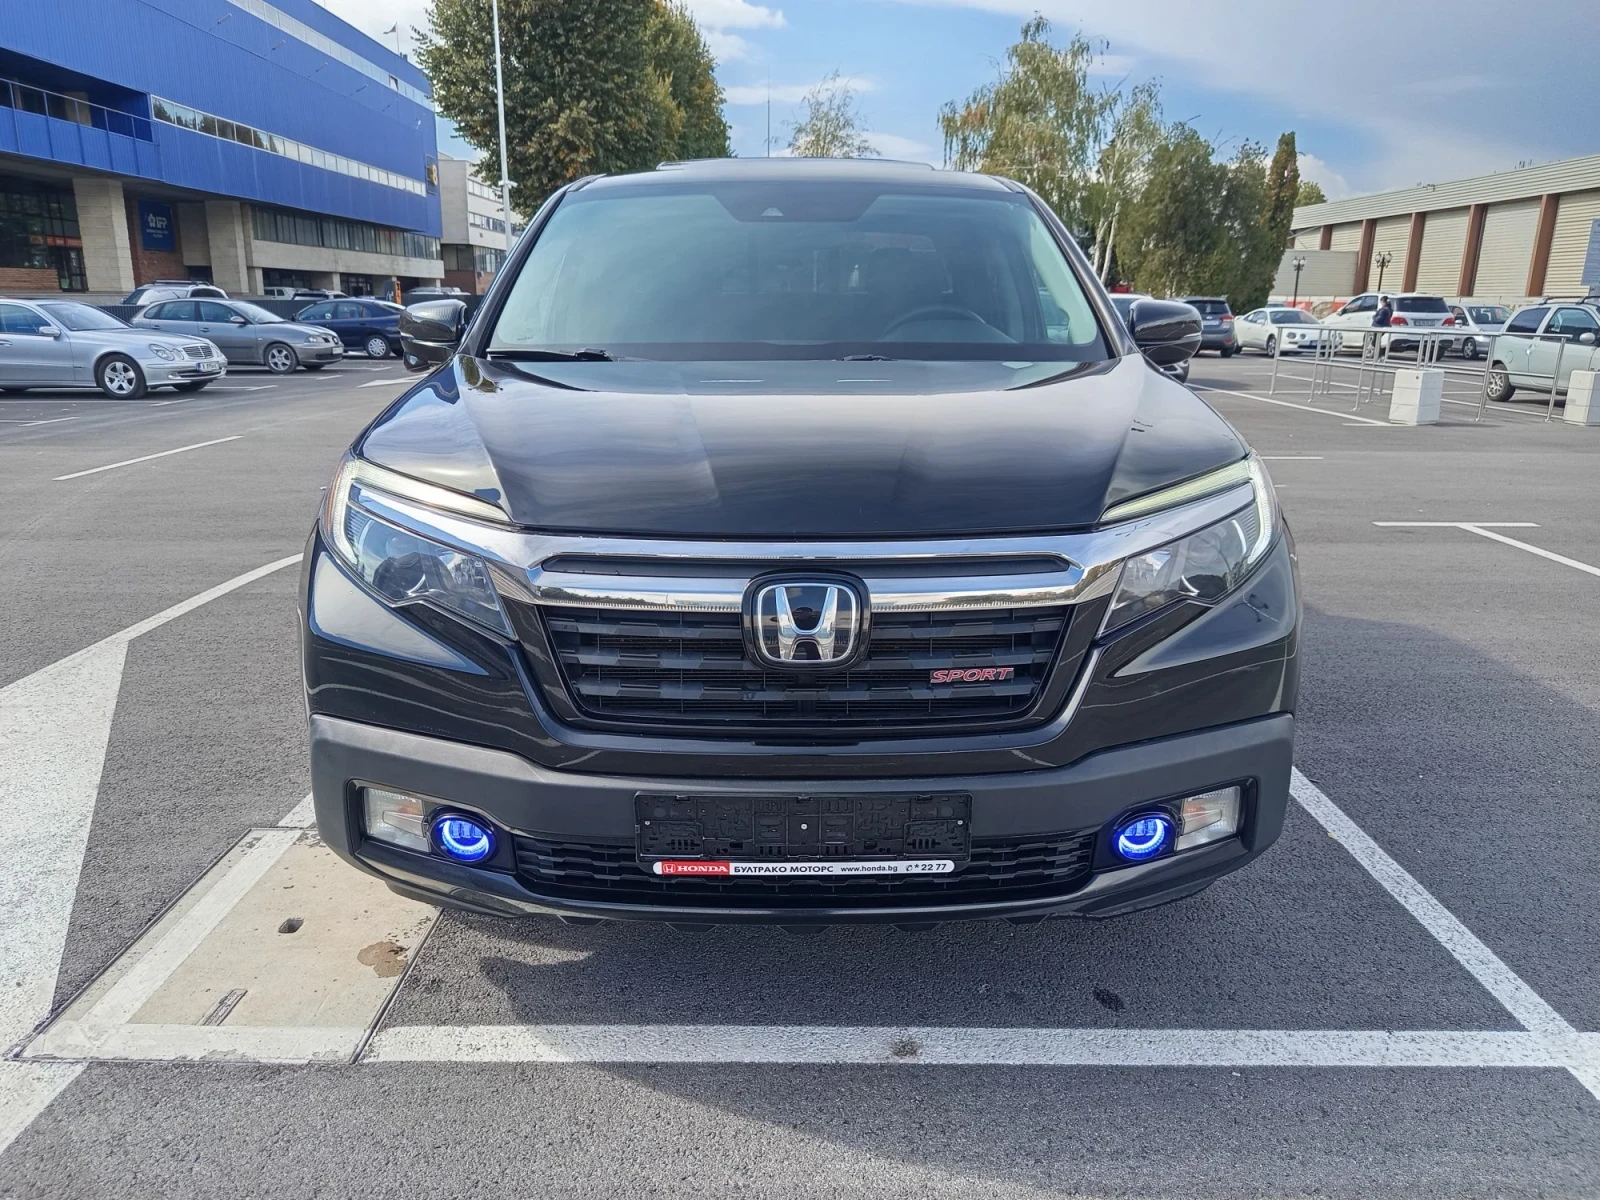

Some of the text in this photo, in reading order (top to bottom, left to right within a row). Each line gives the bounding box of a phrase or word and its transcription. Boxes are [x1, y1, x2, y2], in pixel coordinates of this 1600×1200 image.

[930, 667, 1014, 683] SPORT
[734, 865, 787, 873] БУЛТРАКО
[789, 865, 834, 873] МОТОРС
[840, 865, 898, 873] www.honda.bg
[936, 863, 947, 871] 77
